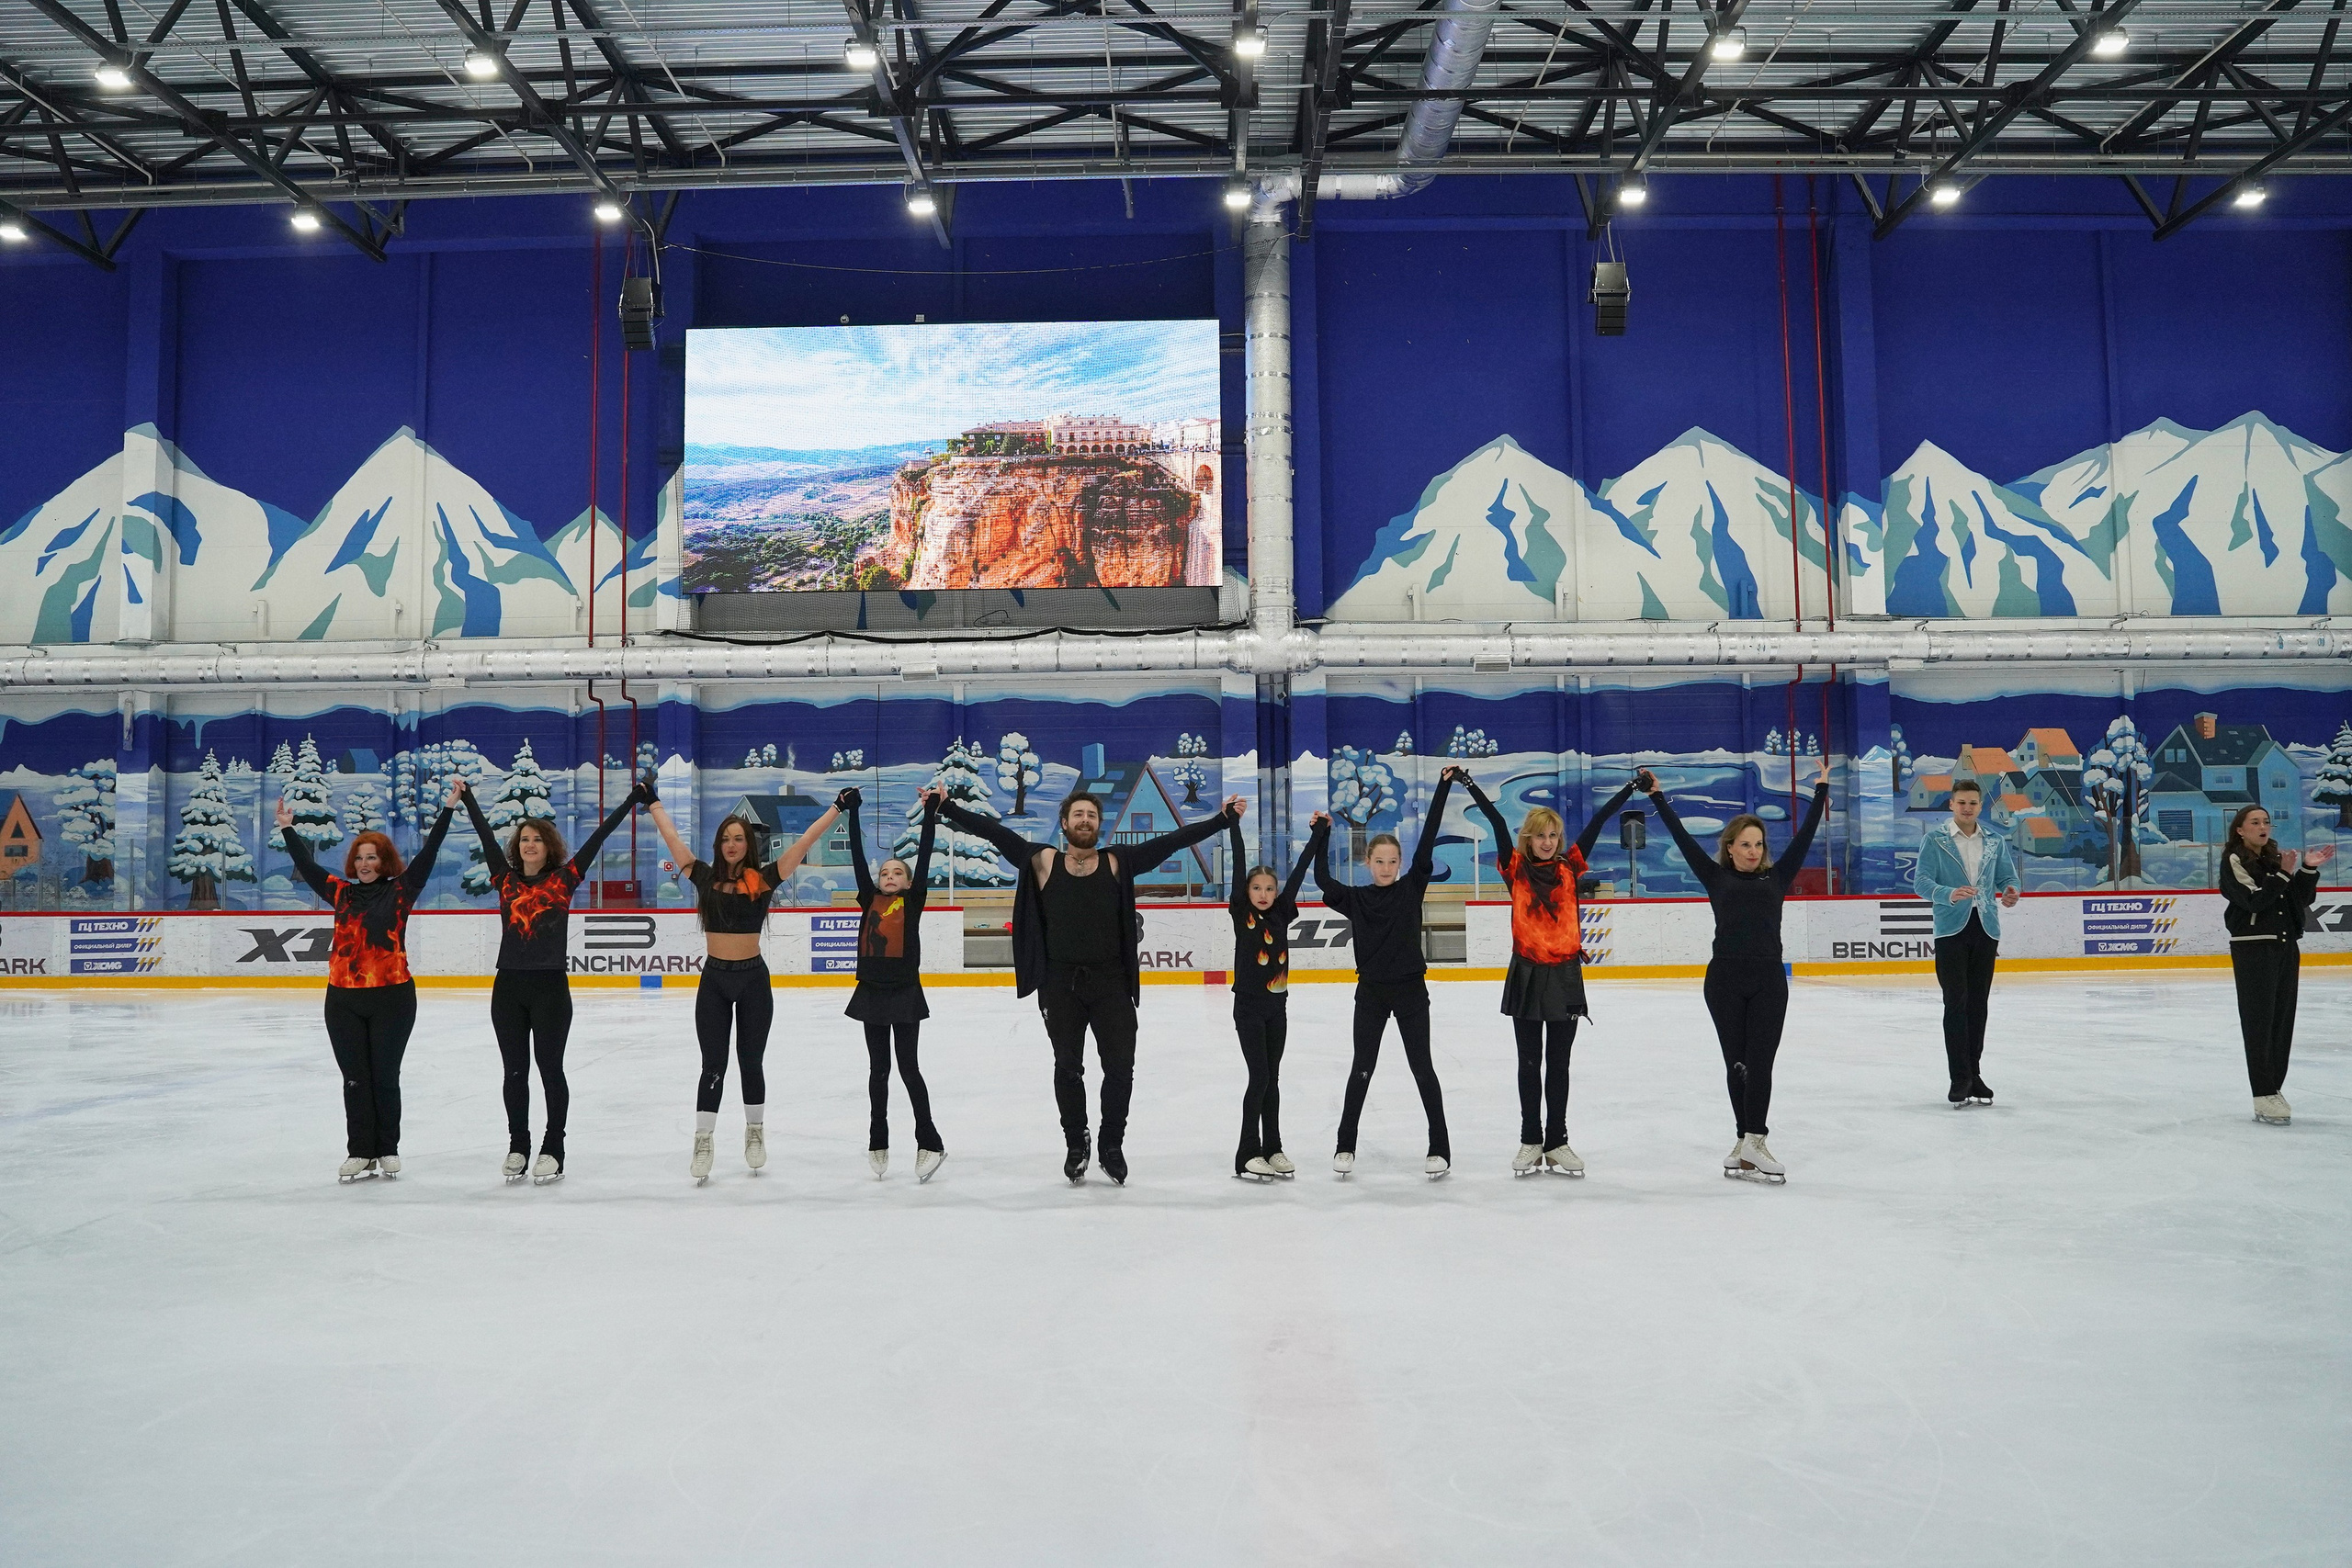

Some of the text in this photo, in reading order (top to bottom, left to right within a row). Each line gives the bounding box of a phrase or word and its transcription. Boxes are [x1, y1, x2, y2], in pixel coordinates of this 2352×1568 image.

[2091, 902, 2143, 913] ГЦ ТЕХНО
[78, 921, 129, 932] ГЦ ТЕХНО
[820, 919, 834, 930] ГЦ
[2108, 942, 2138, 952] XCMG
[93, 961, 123, 971] XCMG
